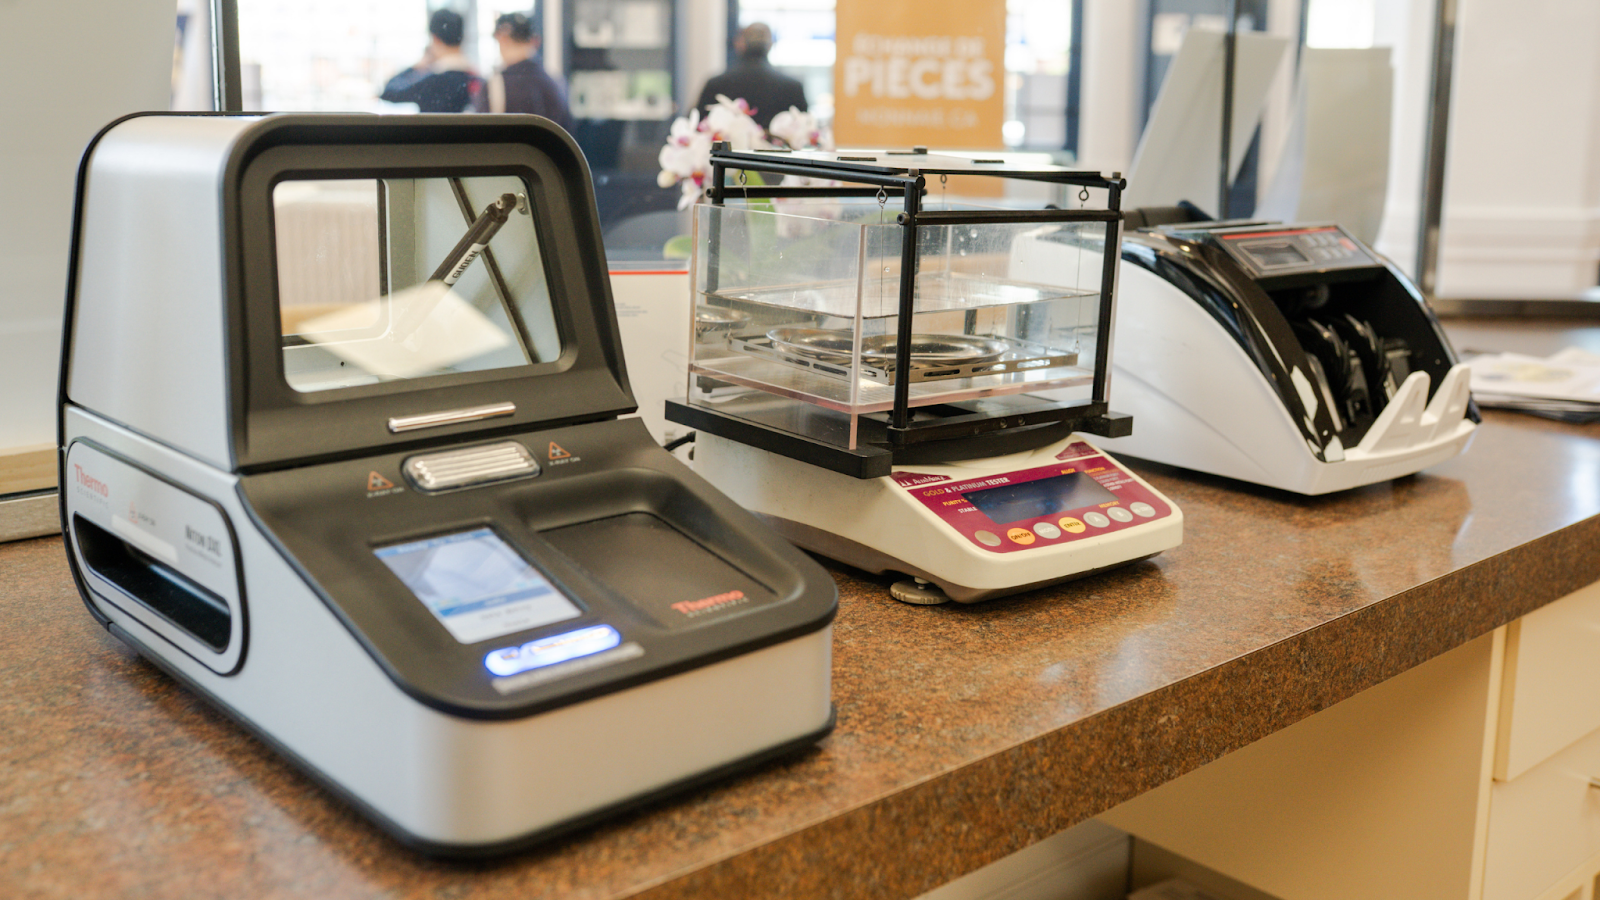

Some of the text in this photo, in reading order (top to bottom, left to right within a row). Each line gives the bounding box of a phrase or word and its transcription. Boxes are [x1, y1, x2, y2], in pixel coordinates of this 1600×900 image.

[74, 463, 109, 498] Thermo
[923, 488, 945, 497] GOLD
[951, 480, 987, 492] PLATINUM
[985, 477, 1010, 486] TESTER
[670, 589, 744, 614] Thermo
